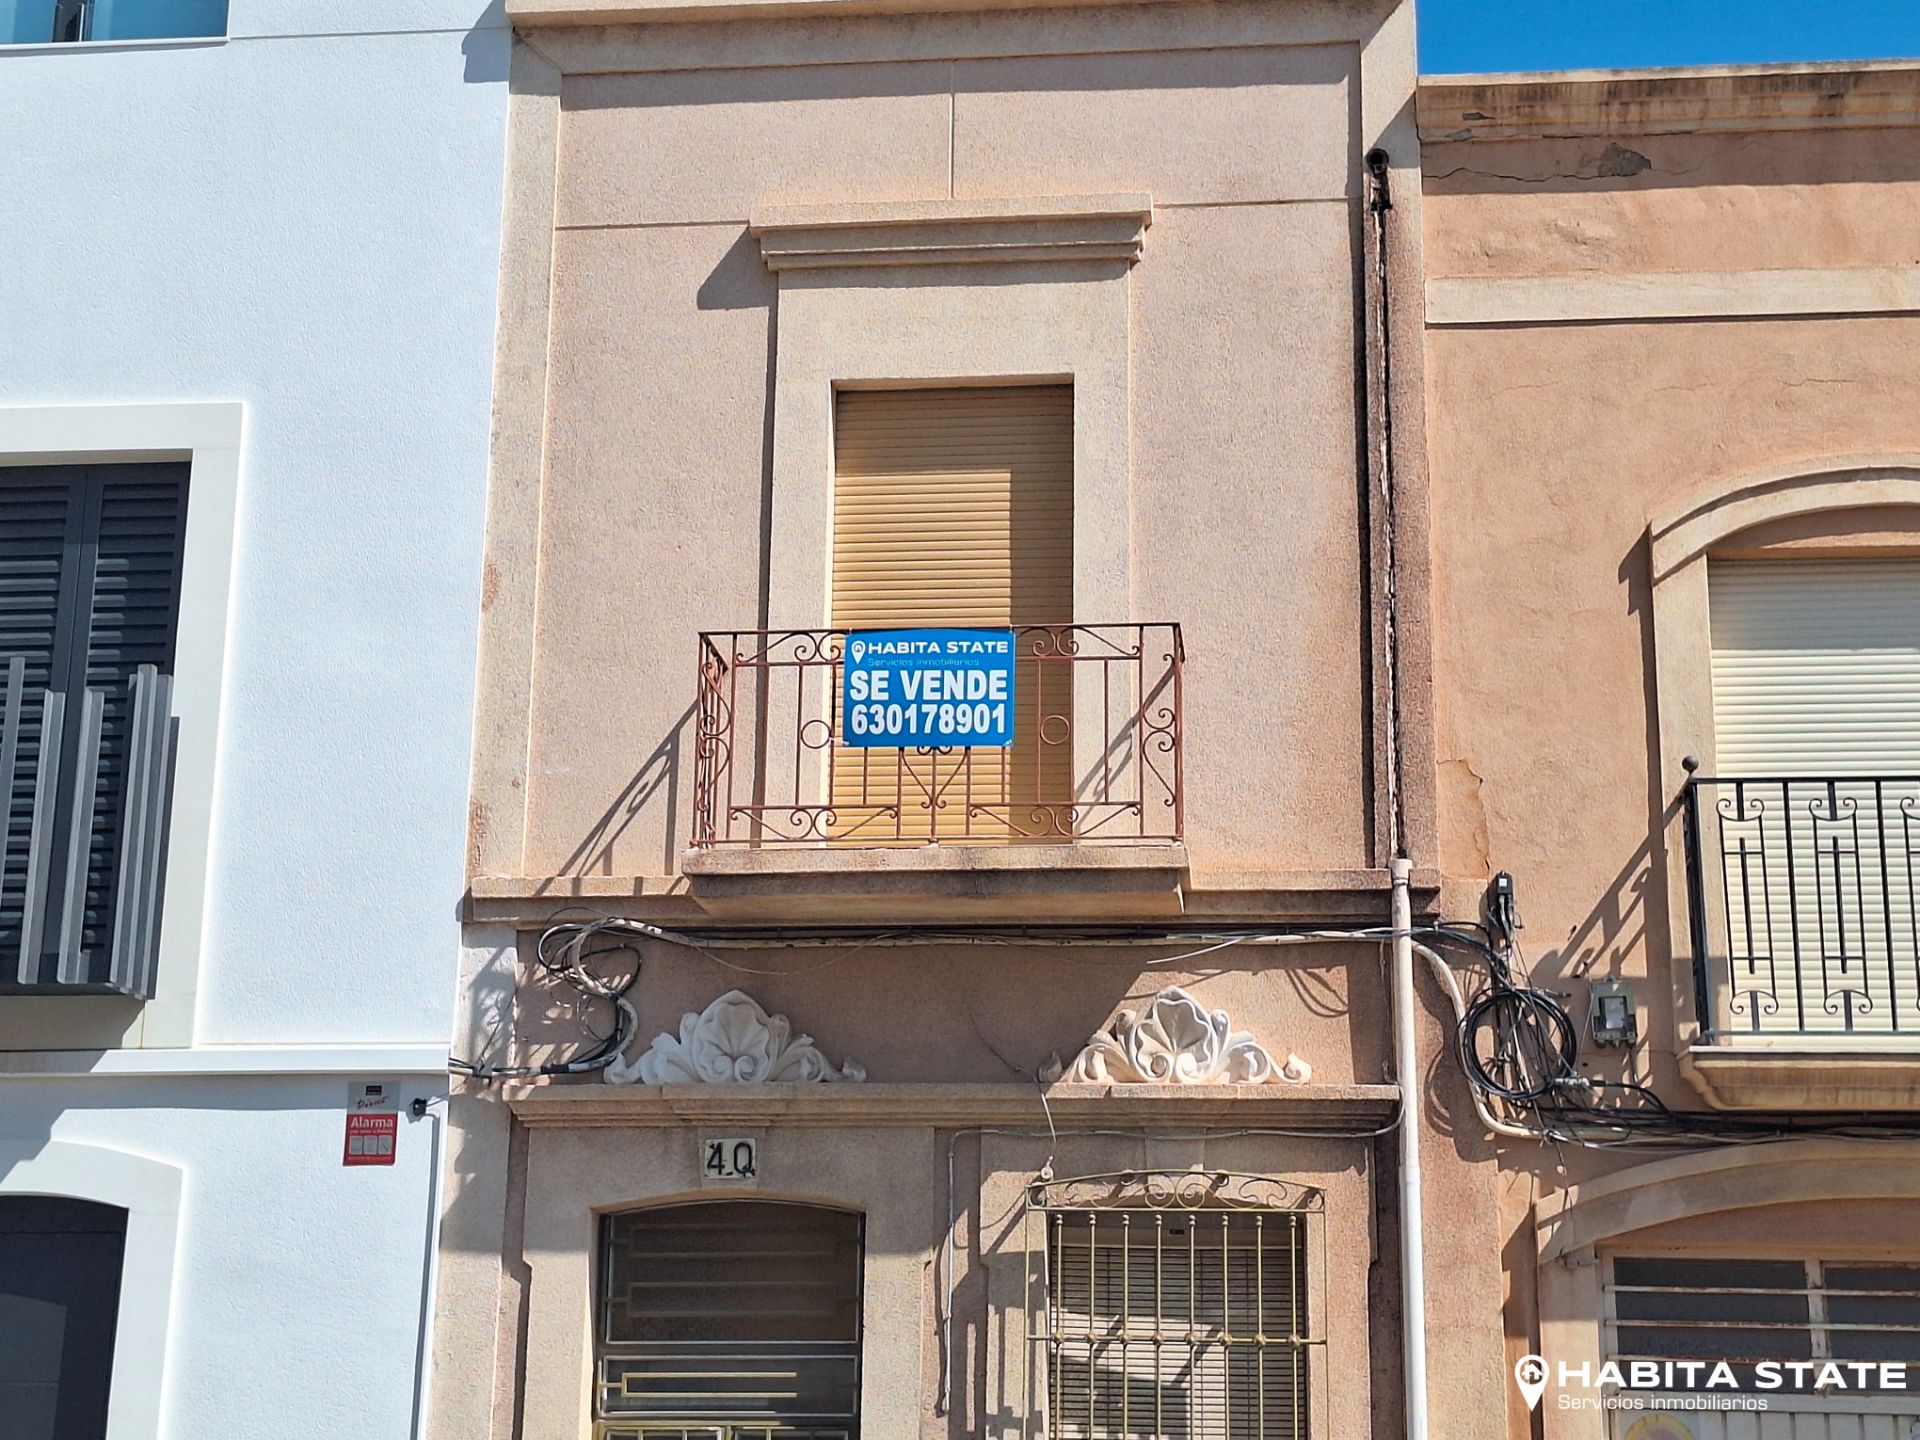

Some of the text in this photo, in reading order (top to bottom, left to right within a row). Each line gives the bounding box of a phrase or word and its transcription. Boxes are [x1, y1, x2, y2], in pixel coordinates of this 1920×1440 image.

[868, 641, 1009, 654] HABITA STATE
[850, 669, 1008, 701] SE VENDE
[851, 703, 1006, 735] 630178901
[350, 1116, 393, 1128] Alarma
